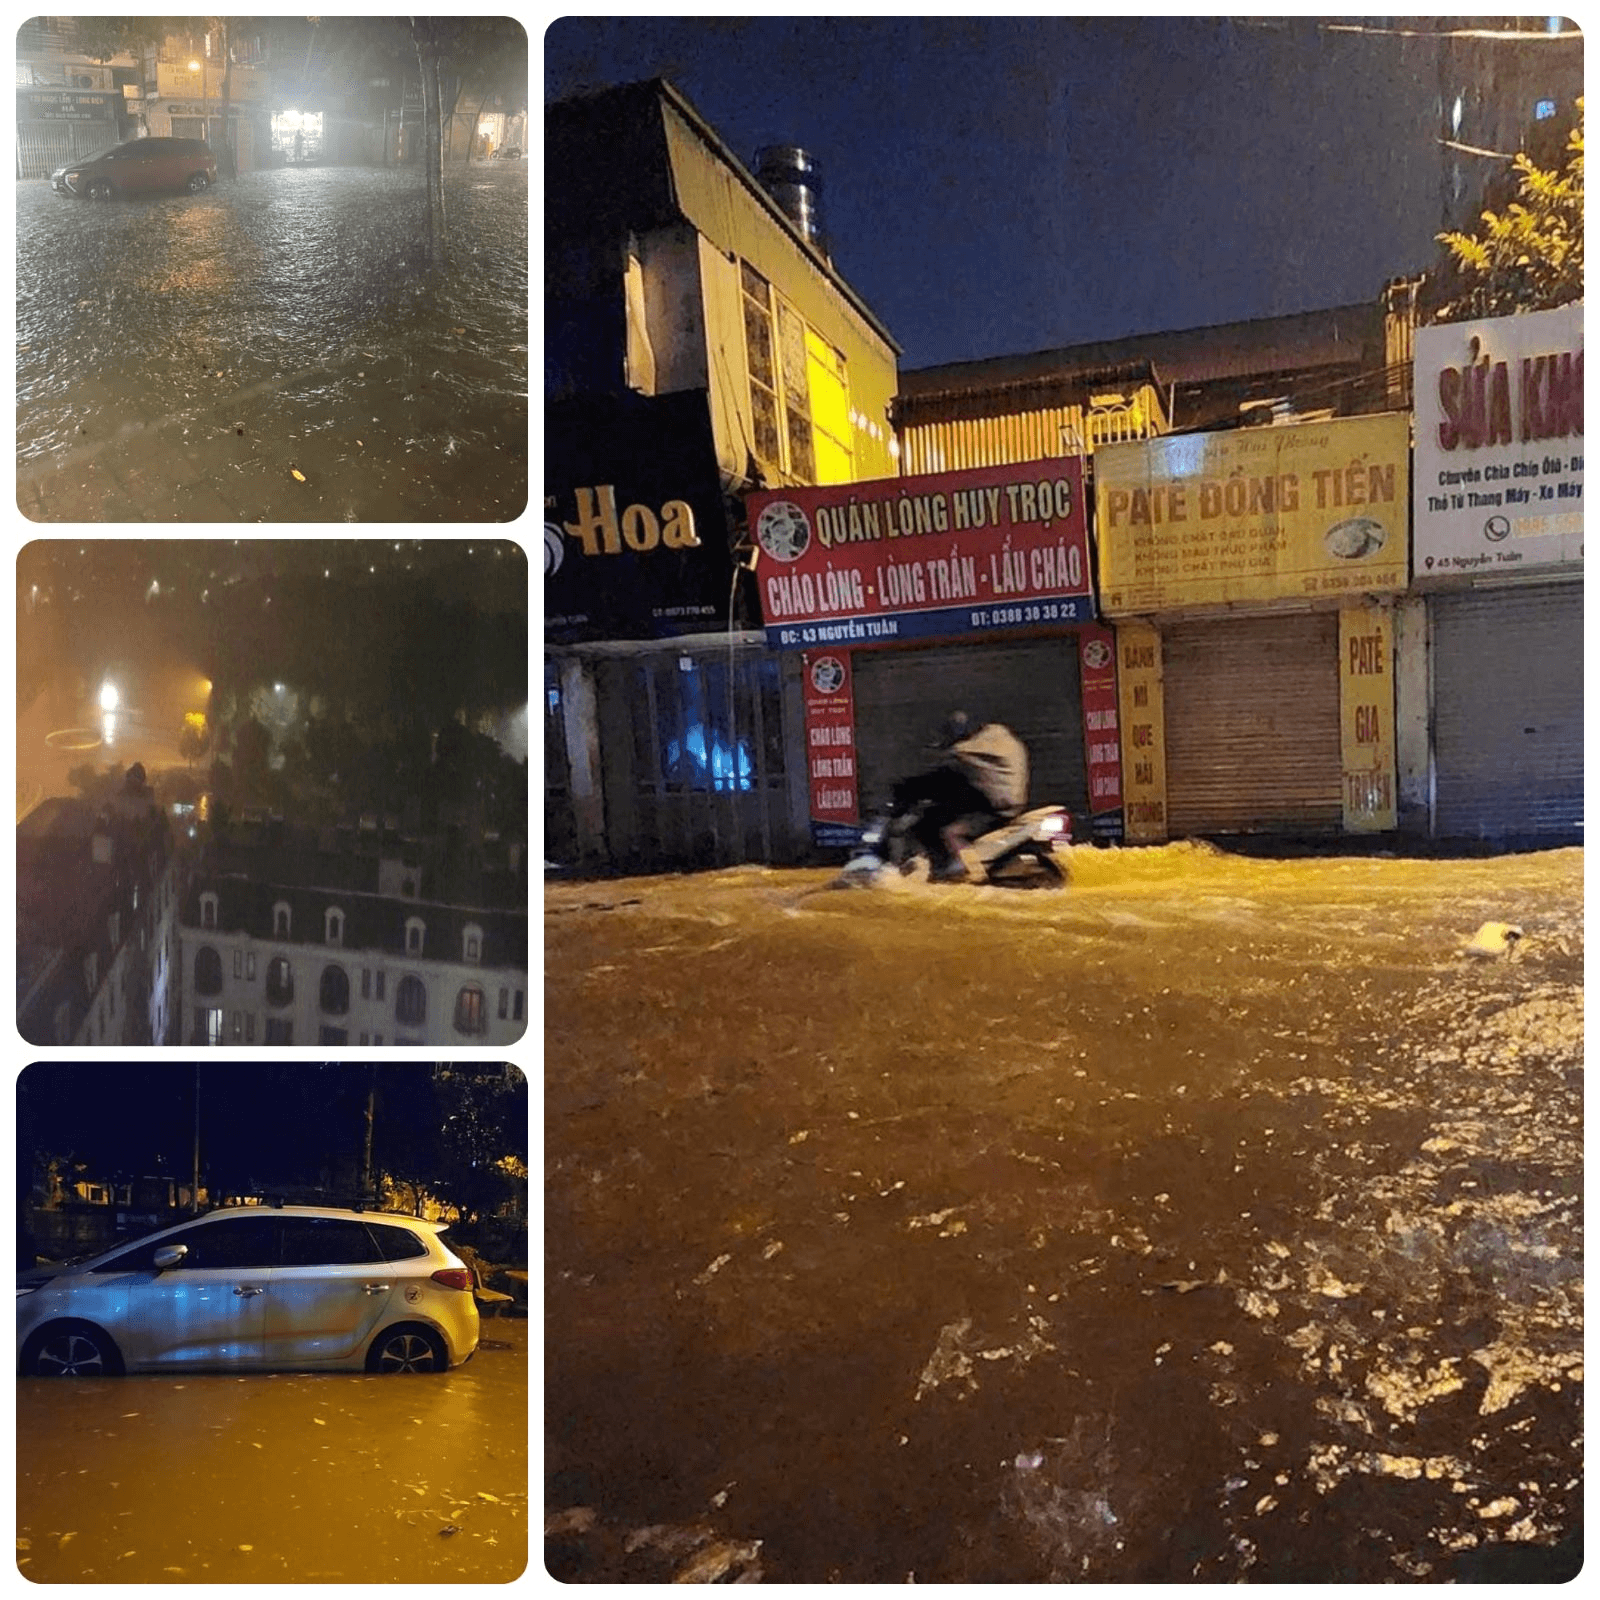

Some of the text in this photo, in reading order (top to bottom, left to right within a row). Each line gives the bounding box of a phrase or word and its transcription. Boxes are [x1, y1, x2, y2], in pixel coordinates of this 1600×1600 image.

[1312, 453, 1395, 509] TIẾN
[1467, 491, 1502, 507] Thang
[1505, 488, 1530, 504] Máy
[1539, 484, 1554, 500] Xe
[1558, 481, 1582, 498] Máy
[563, 484, 701, 555] Hoa
[816, 479, 1070, 549] QUÁN LÒNG HUY TRỌC
[767, 566, 815, 616] CHÁO
[816, 561, 865, 611] LÒNG
[877, 554, 926, 606] LÒNG
[1030, 537, 1081, 590] CHÁO
[802, 628, 817, 642] 43
[818, 620, 865, 641] NGUYỄN
[866, 619, 898, 636] TUÂN
[1061, 603, 1076, 618] 22
[1355, 705, 1380, 743] GIA
